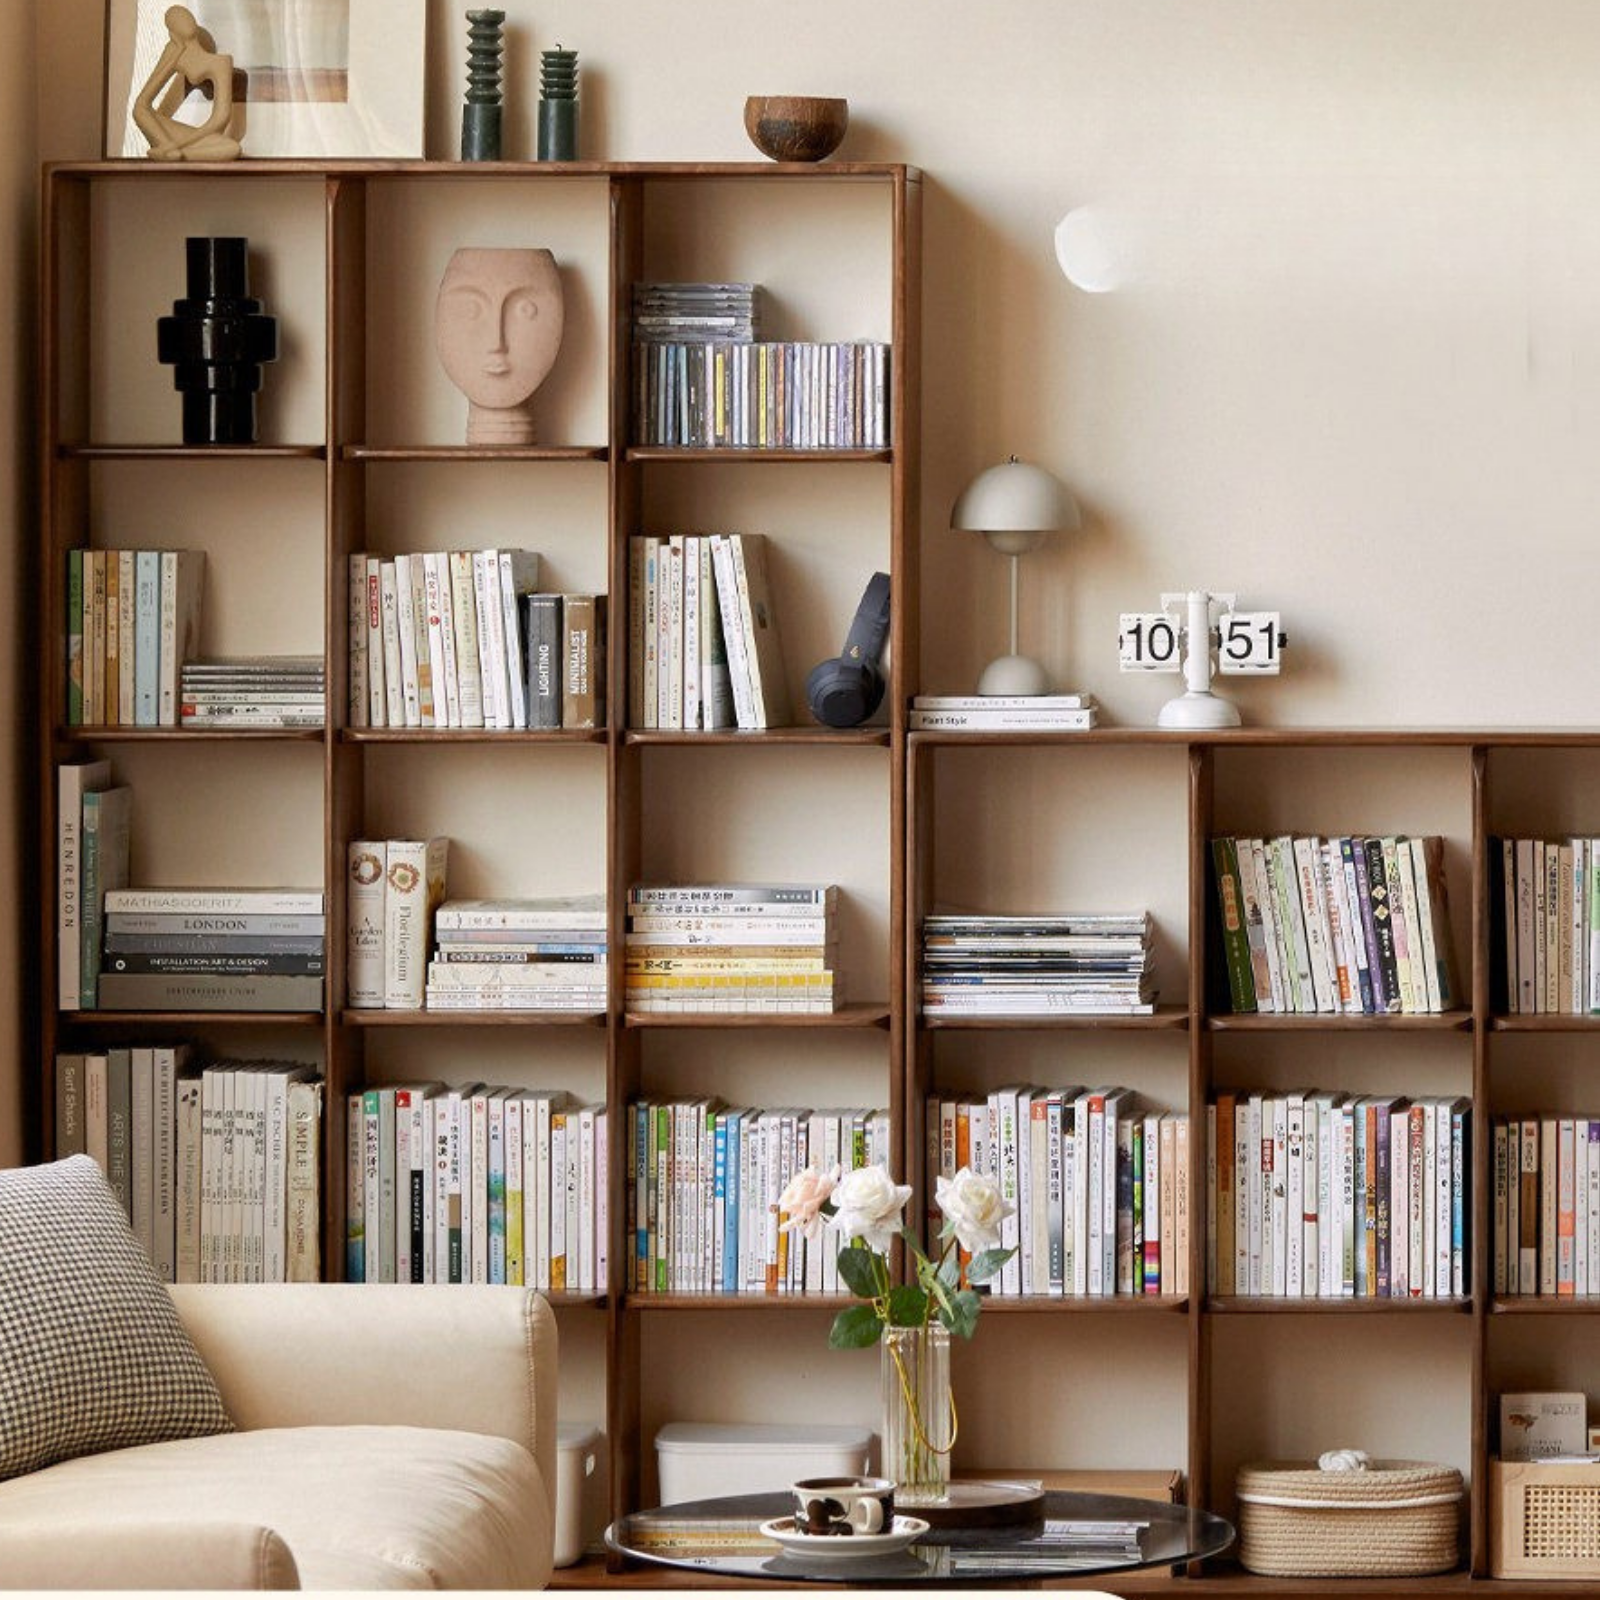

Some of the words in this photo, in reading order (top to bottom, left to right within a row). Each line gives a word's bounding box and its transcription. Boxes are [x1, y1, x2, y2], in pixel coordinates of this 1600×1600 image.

[1126, 622, 1175, 662] 10
[1225, 620, 1275, 660] 51
[538, 644, 549, 696] LIGHTING
[570, 629, 580, 694] MINIMALIST
[922, 716, 944, 725] Plant
[945, 716, 967, 726] Style
[64, 822, 75, 928] HENREDON
[183, 919, 248, 931] LONDON
[398, 906, 412, 981] Florilegium
[150, 958, 209, 966] INSTALLATION
[211, 958, 227, 966] ART
[228, 958, 235, 966] &
[236, 958, 269, 966] DESIGN
[65, 1067, 76, 1093] Surf
[65, 1094, 75, 1135] Shacks
[113, 1113, 123, 1146] ARTS
[273, 1119, 282, 1161] ESCHER
[296, 1111, 308, 1168] SIMPLE
[113, 1151, 123, 1177] THE
